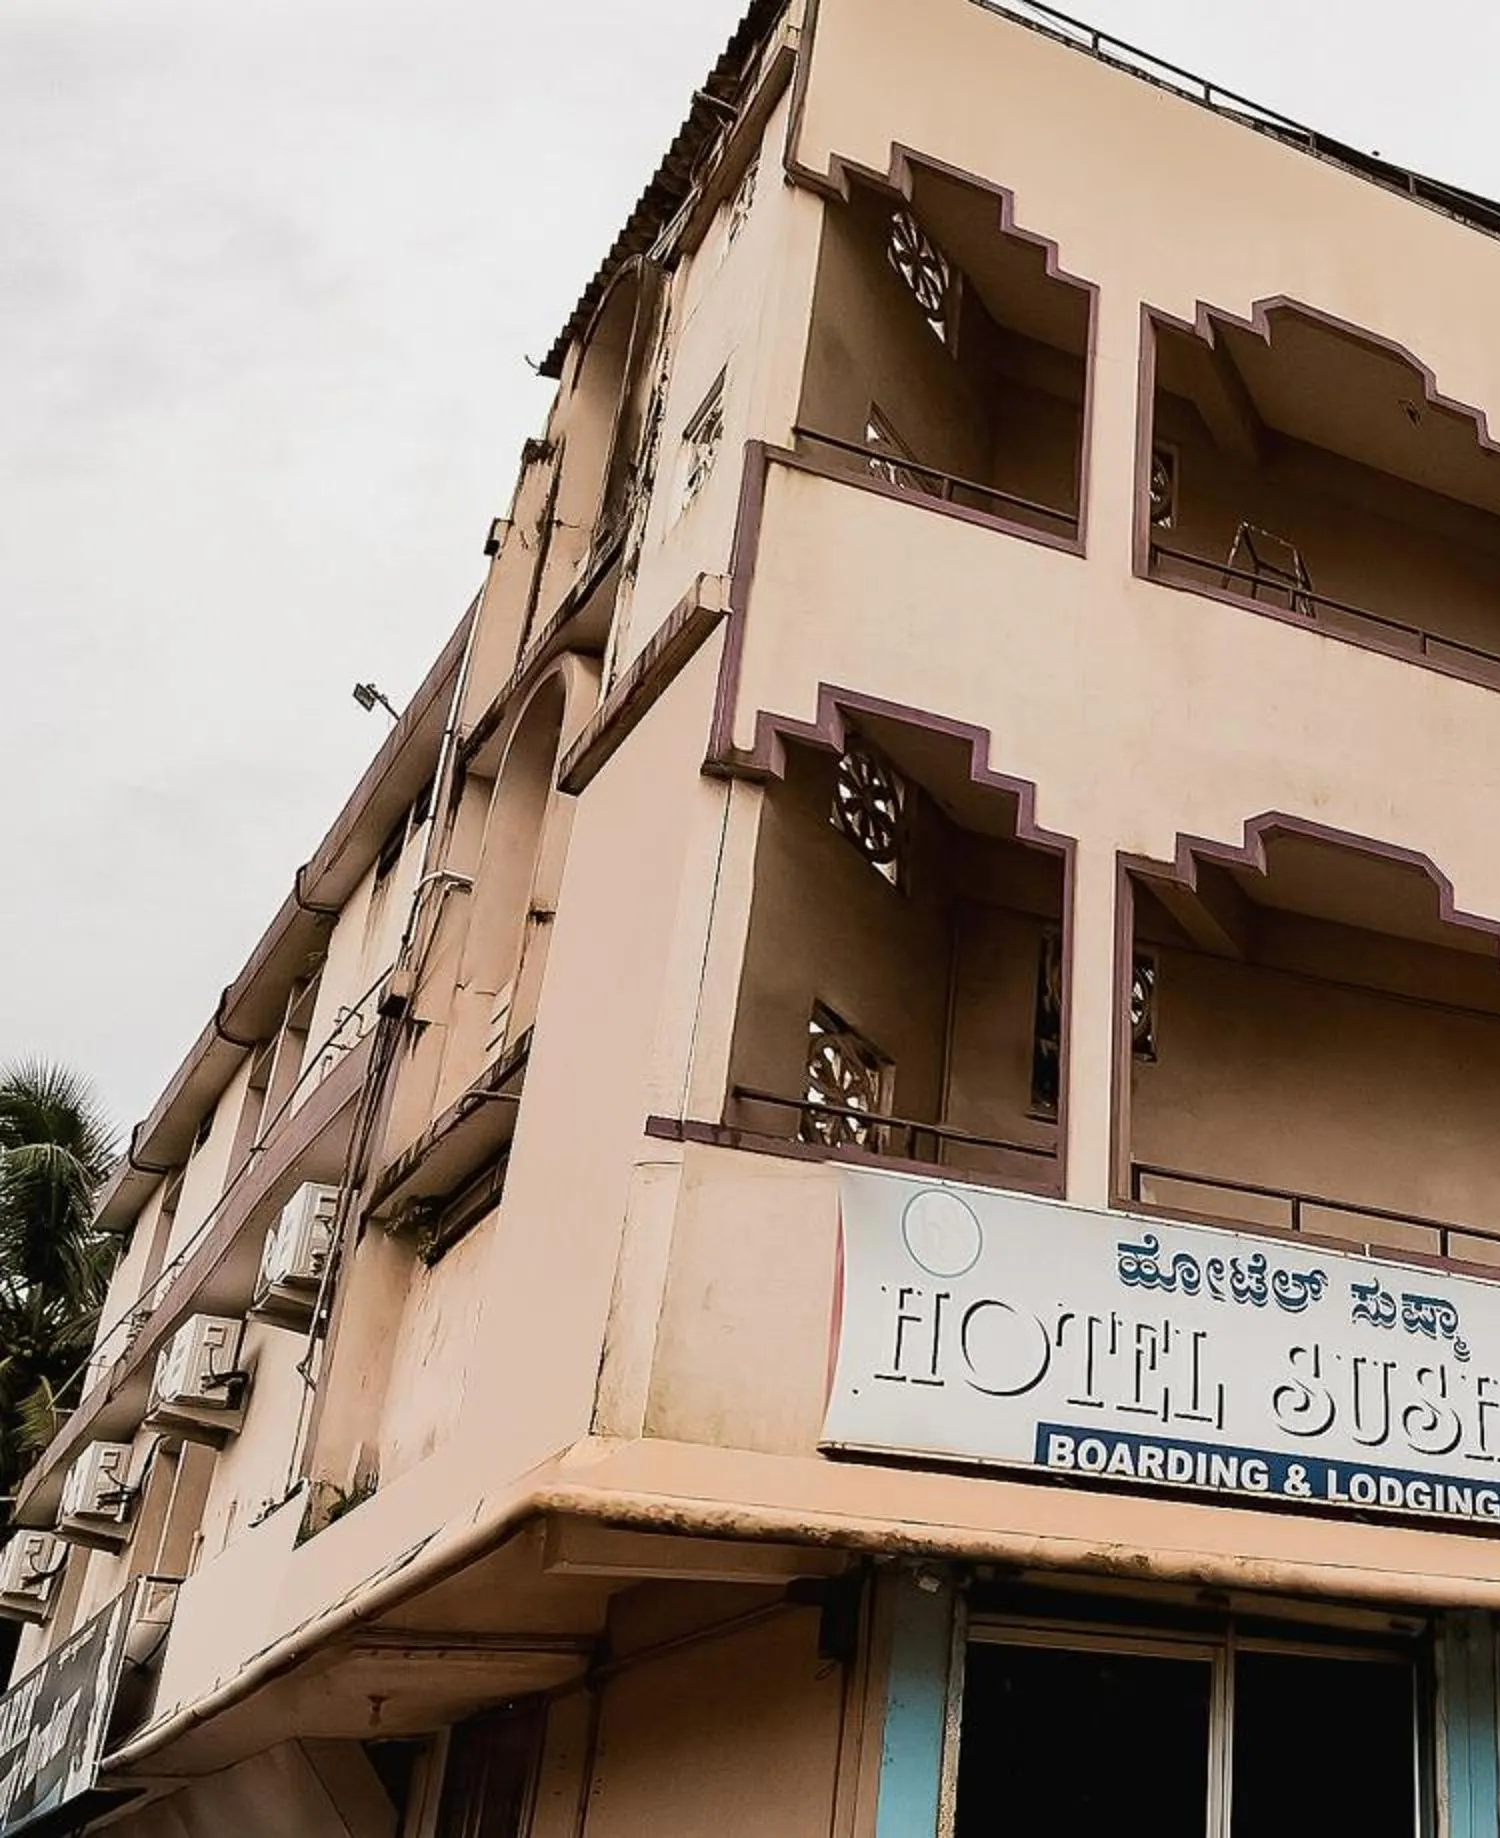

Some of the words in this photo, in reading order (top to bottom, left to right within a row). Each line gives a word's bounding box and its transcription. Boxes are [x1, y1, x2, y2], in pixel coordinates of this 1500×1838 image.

[1116, 1233, 1328, 1314] ಹೋಟೆಲ್
[874, 1283, 1228, 1431] HOTEL
[1046, 1434, 1271, 1494] BOARDING
[1283, 1462, 1314, 1499] &
